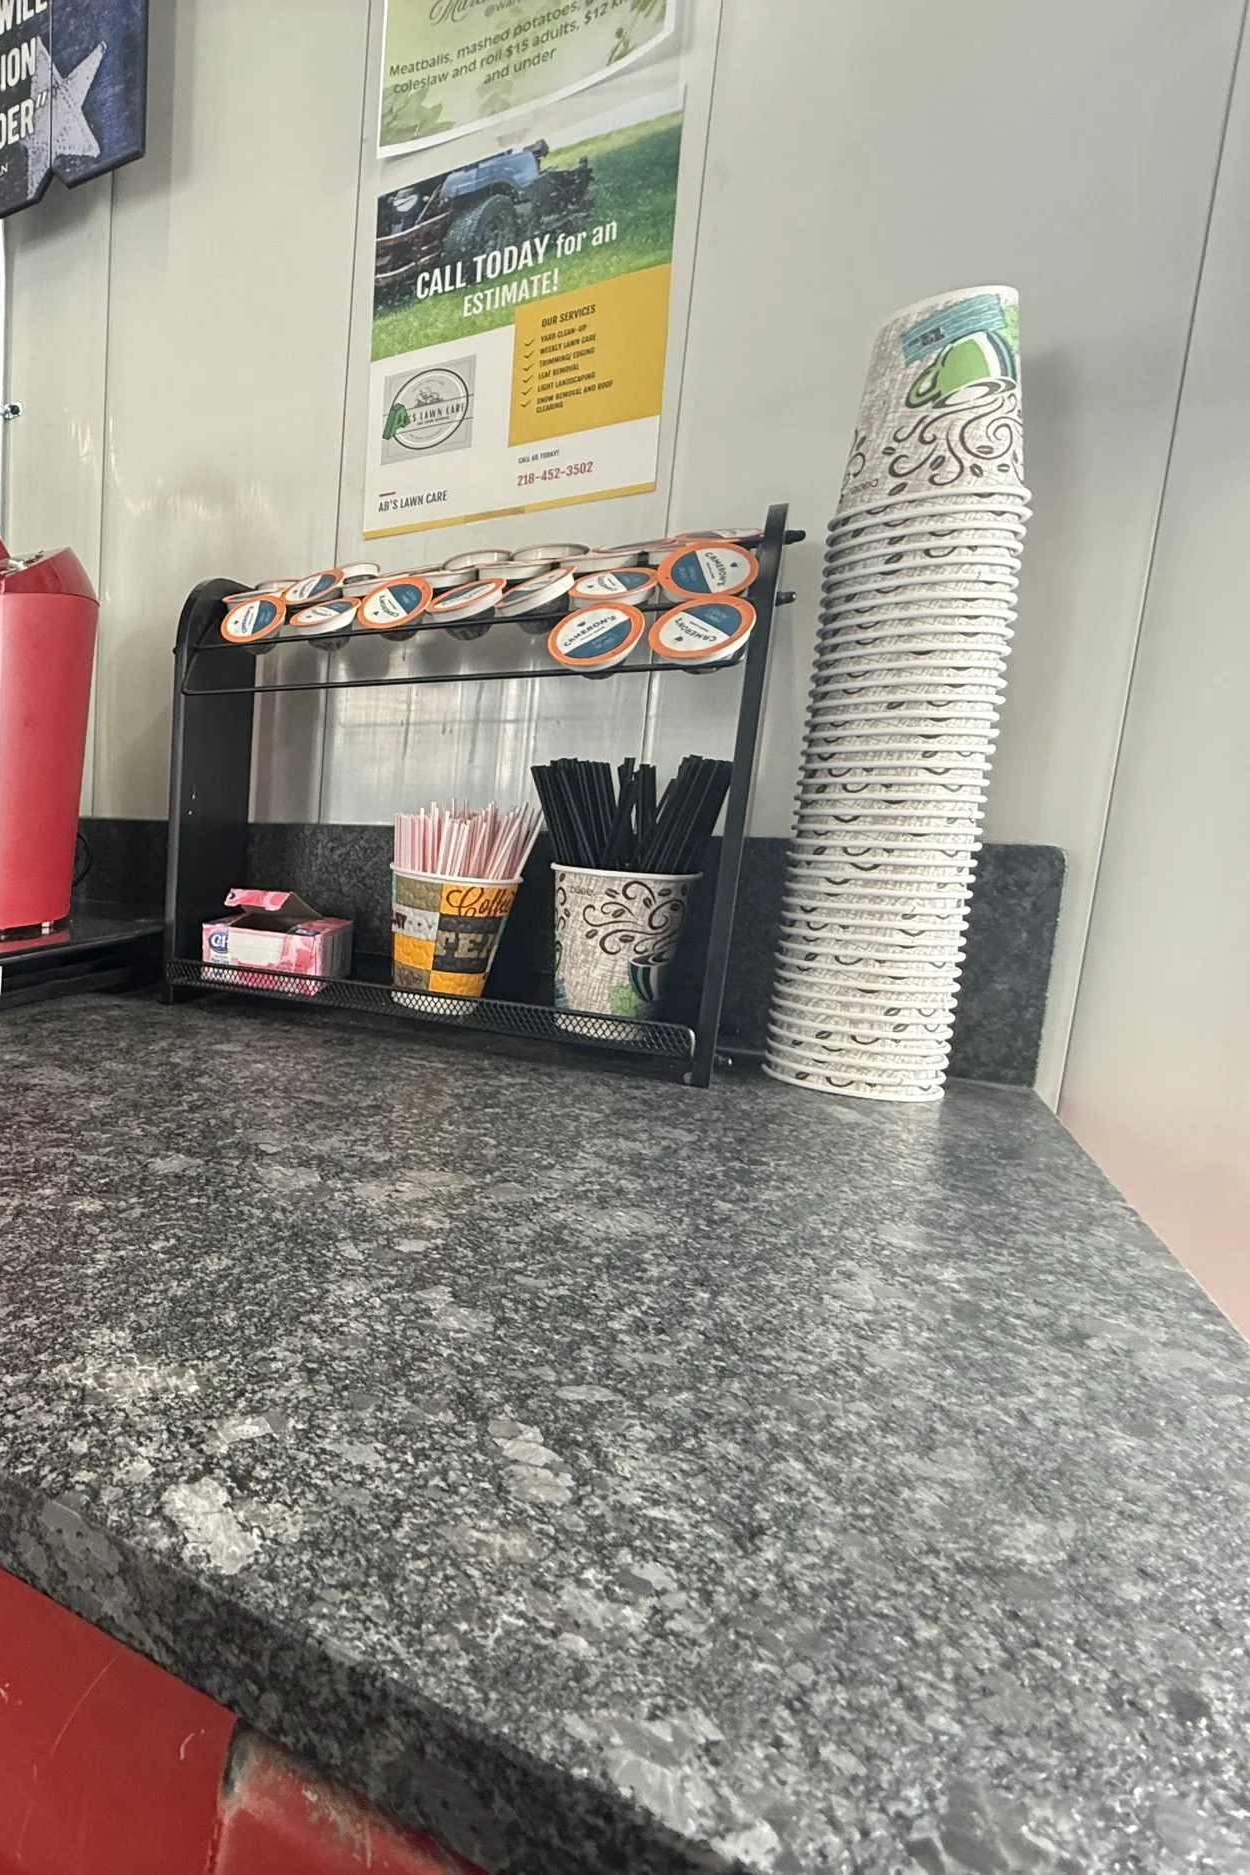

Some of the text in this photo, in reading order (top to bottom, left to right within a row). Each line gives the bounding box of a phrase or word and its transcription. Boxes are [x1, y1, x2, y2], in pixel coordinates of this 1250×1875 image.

[389, 50, 452, 77] Meatballs,
[457, 28, 511, 59] mashed
[513, 3, 581, 41] potatoes,
[393, 68, 449, 95] coleslaw
[451, 59, 477, 80] and
[479, 48, 502, 71] roll
[505, 39, 529, 60] $15
[532, 20, 580, 48] adults,
[483, 47, 558, 86] and under
[415, 220, 617, 300] CALL TODAY for an
[463, 269, 559, 318] ESTIMATE!
[541, 304, 596, 328] OUR SERVICES
[540, 324, 587, 342] YARD CLEAN-UP
[540, 333, 596, 355] WEEKLY LAWN CARE
[537, 371, 596, 393] LIGHT LANDSCAPING
[538, 363, 579, 381] LEAF REMOVAL
[537, 379, 613, 405] SNOW REMOVAL AND ROOF
[419, 408, 442, 421] LAWN
[446, 402, 465, 415] CARE
[536, 401, 563, 414] CLEARING
[518, 455, 530, 464] CALL
[531, 453, 539, 461] US
[517, 461, 594, 487] 218-452-3502
[378, 490, 448, 512] AB'S LAWN CARE
